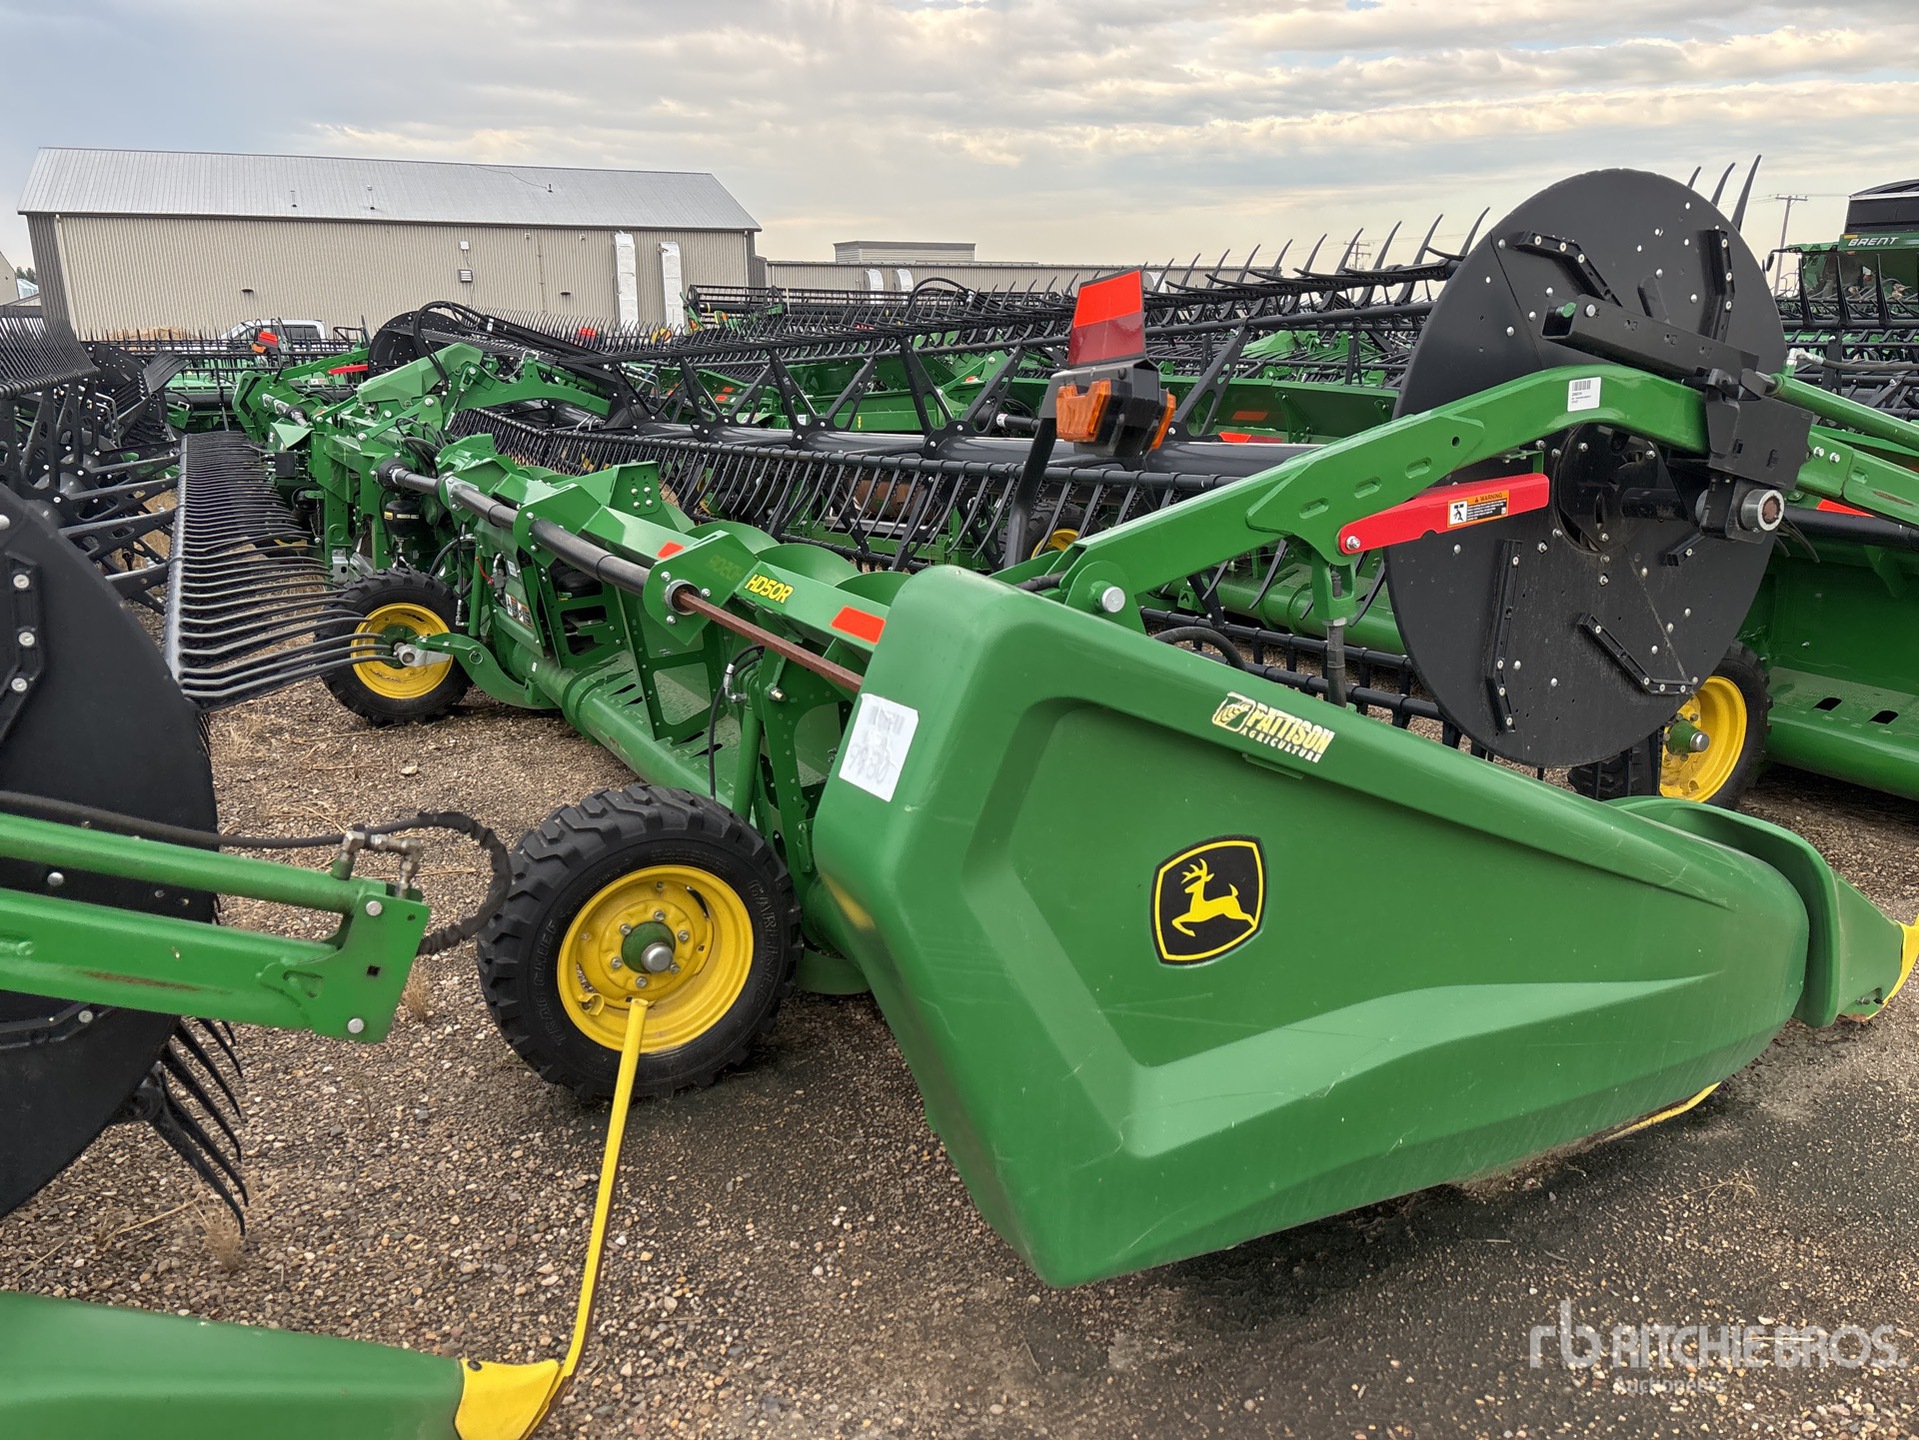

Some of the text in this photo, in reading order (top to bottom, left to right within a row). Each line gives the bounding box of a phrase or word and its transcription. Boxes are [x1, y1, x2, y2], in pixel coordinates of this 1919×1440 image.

[1848, 237, 1899, 247] BRENT
[1480, 492, 1503, 501] WARNING
[744, 574, 795, 604] HD50R
[1245, 702, 1336, 755] PATTISON
[1240, 727, 1322, 765] AGRICULTURE
